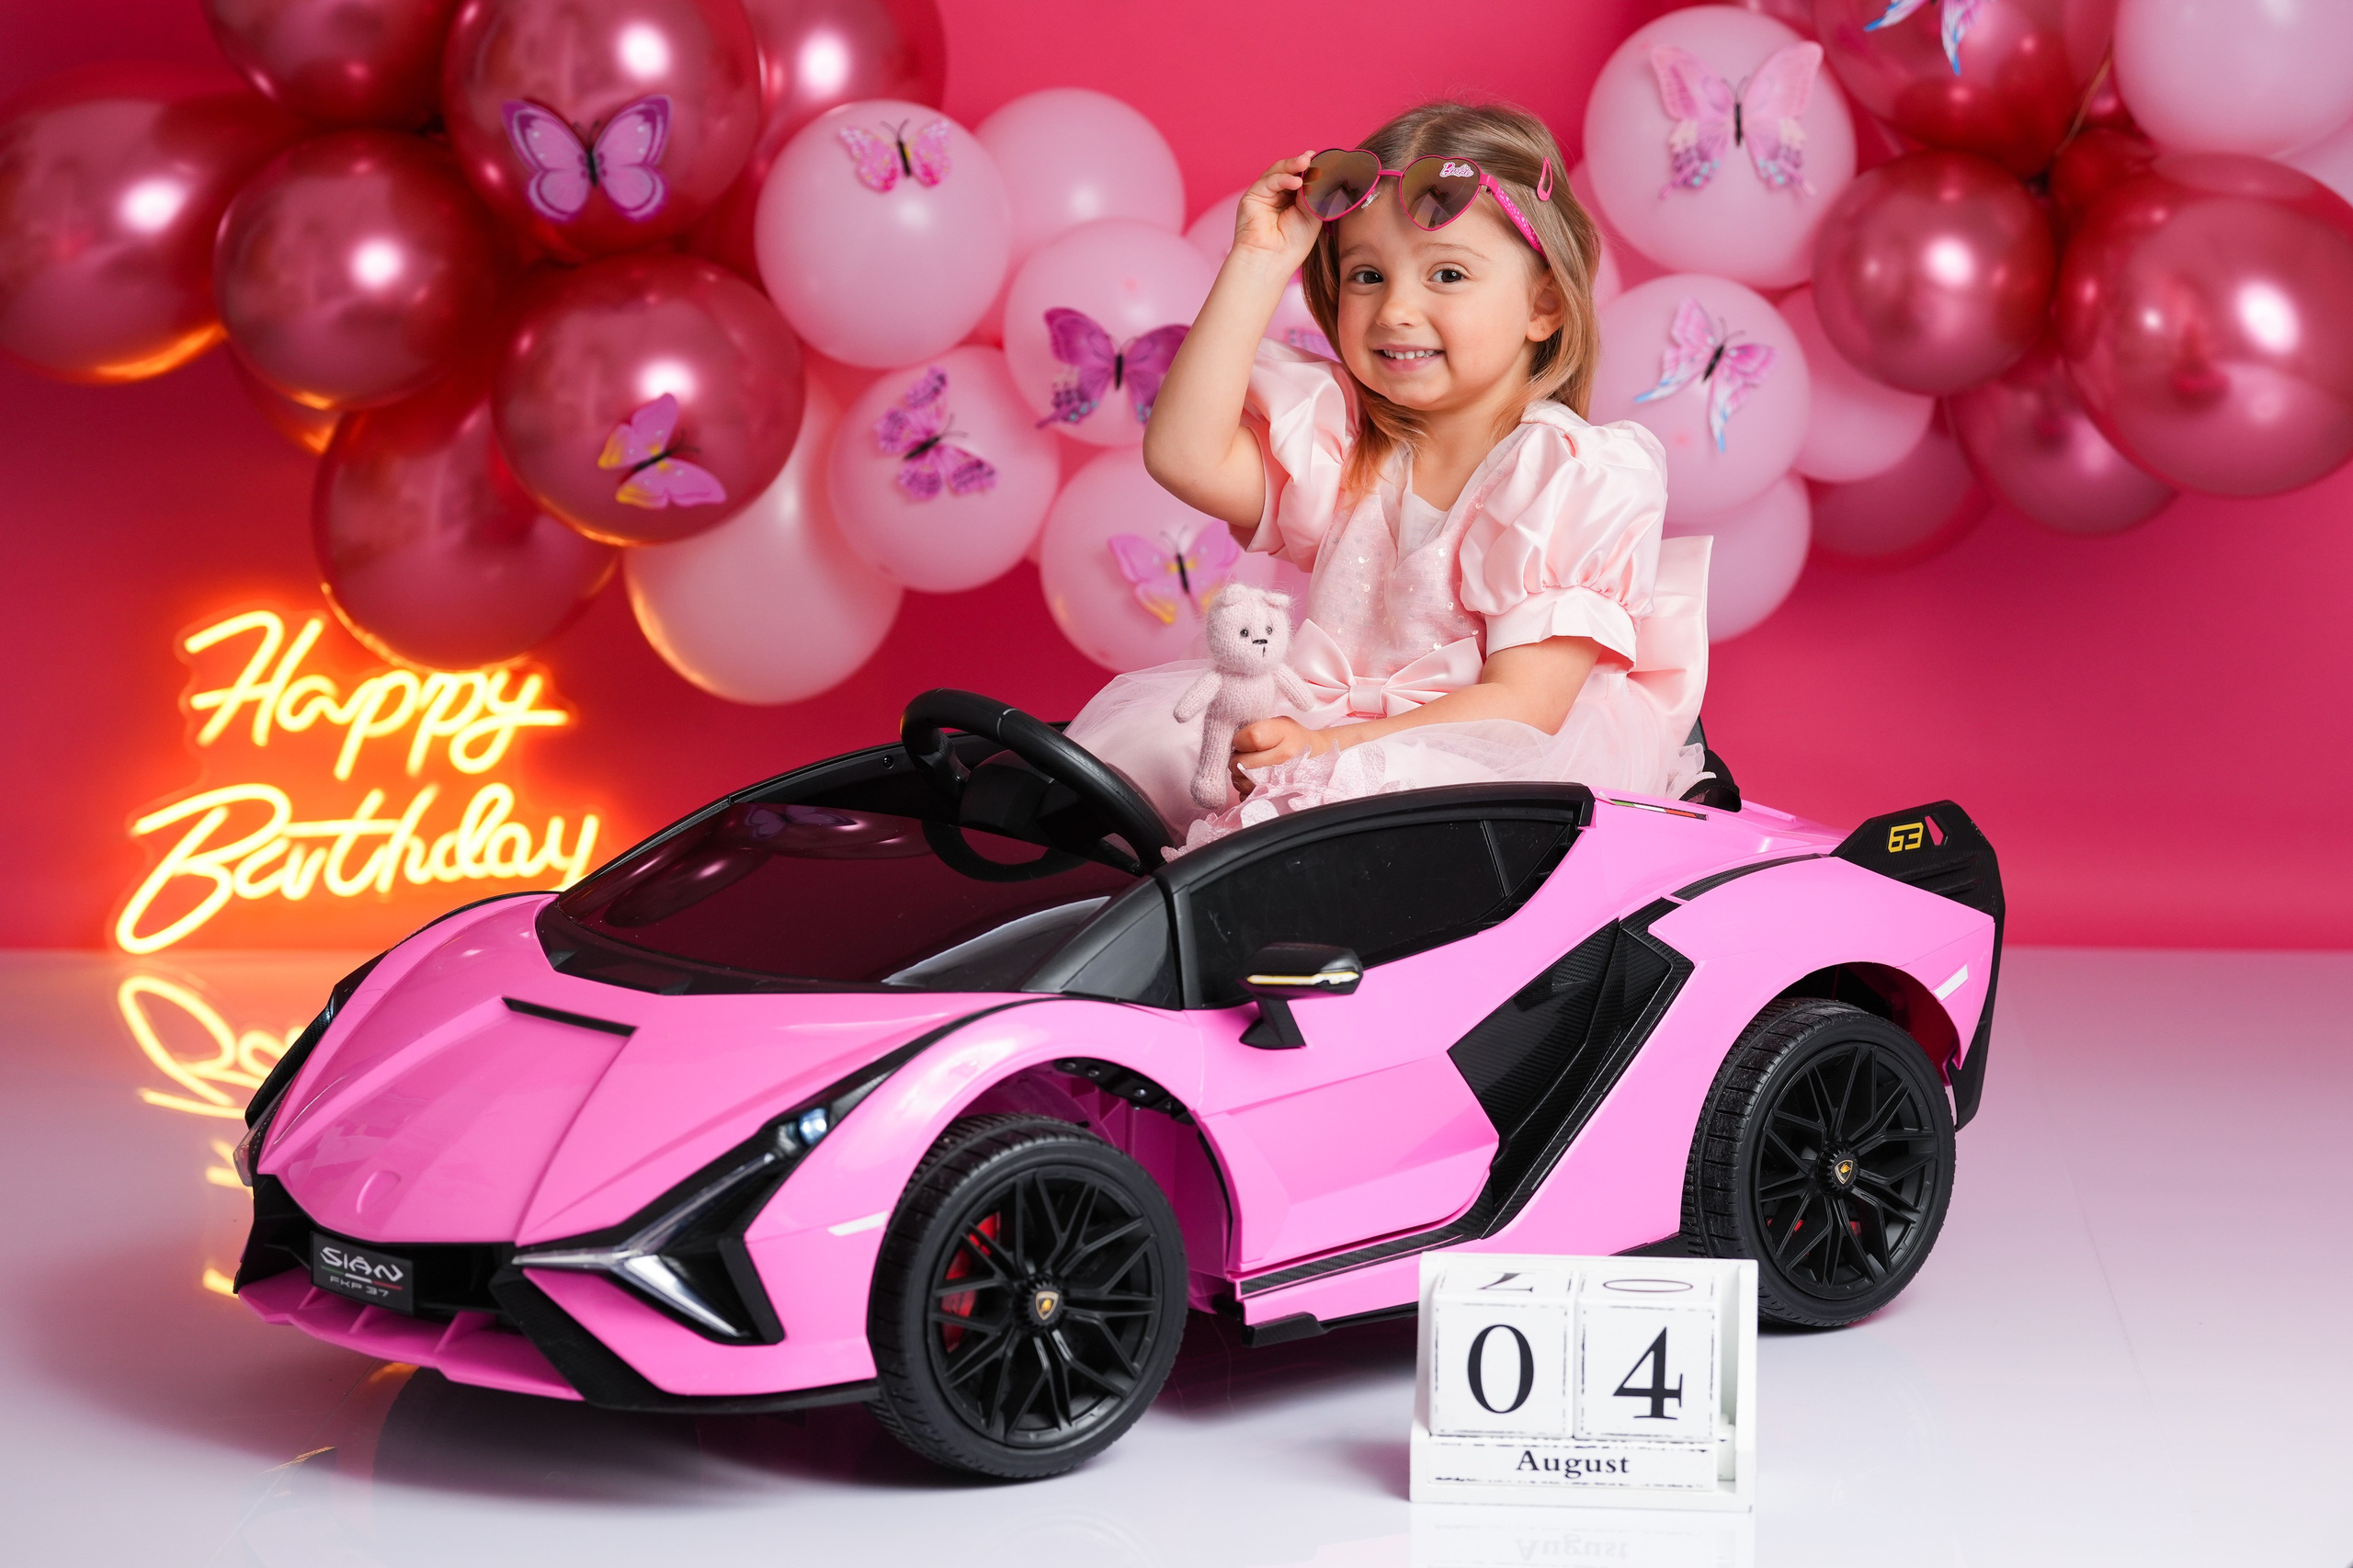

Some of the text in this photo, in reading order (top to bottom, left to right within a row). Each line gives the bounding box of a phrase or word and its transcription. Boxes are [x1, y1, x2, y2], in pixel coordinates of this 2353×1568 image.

[184, 609, 569, 781] Happy
[1888, 822, 1924, 853] 63
[115, 781, 600, 955] Birthday
[329, 1275, 390, 1297] FKP 37
[1515, 1449, 1631, 1479] August
